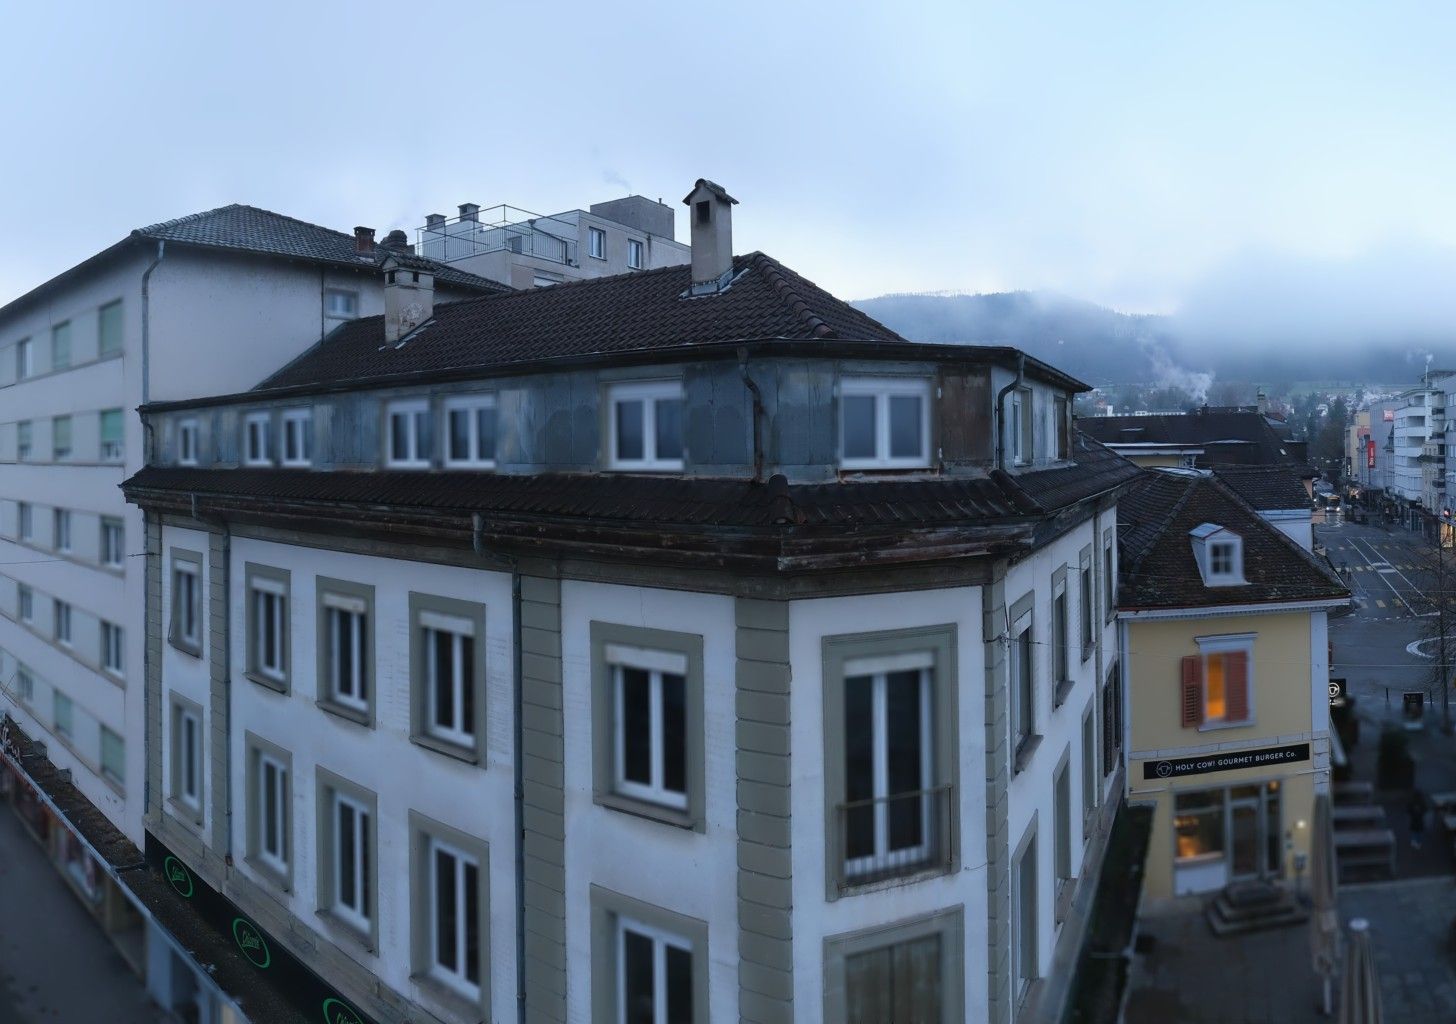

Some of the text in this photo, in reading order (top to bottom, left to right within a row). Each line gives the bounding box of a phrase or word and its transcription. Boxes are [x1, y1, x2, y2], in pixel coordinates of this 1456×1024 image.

[1175, 762, 1194, 771] HOLY
[1196, 760, 1216, 769] COW!
[1217, 755, 1252, 766] GOURMET
[1255, 752, 1284, 762] BURGER
